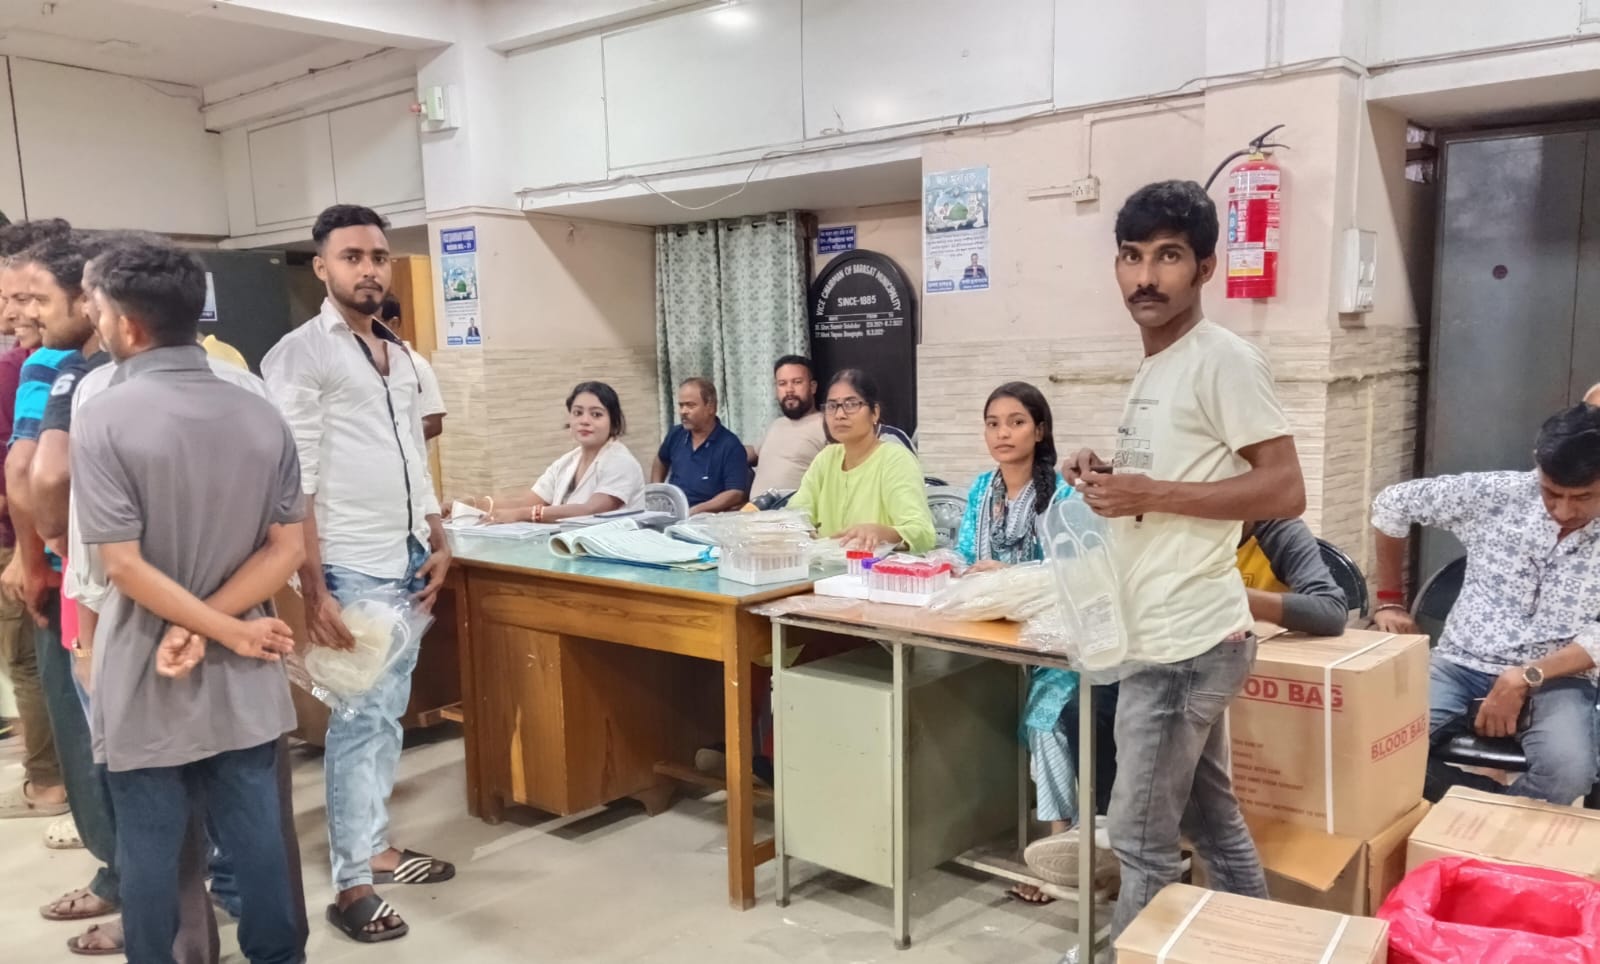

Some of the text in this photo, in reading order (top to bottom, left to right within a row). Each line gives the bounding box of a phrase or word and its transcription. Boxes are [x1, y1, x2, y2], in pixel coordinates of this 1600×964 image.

[816, 264, 902, 316] VICE CHAIRMAN OF BARASAT MUNICIPALITY
[837, 295, 877, 307] SINCE-1885
[51, 373, 76, 396] 6
[1288, 683, 1344, 708] BAG
[1371, 717, 1427, 761] BLOOD BAG
